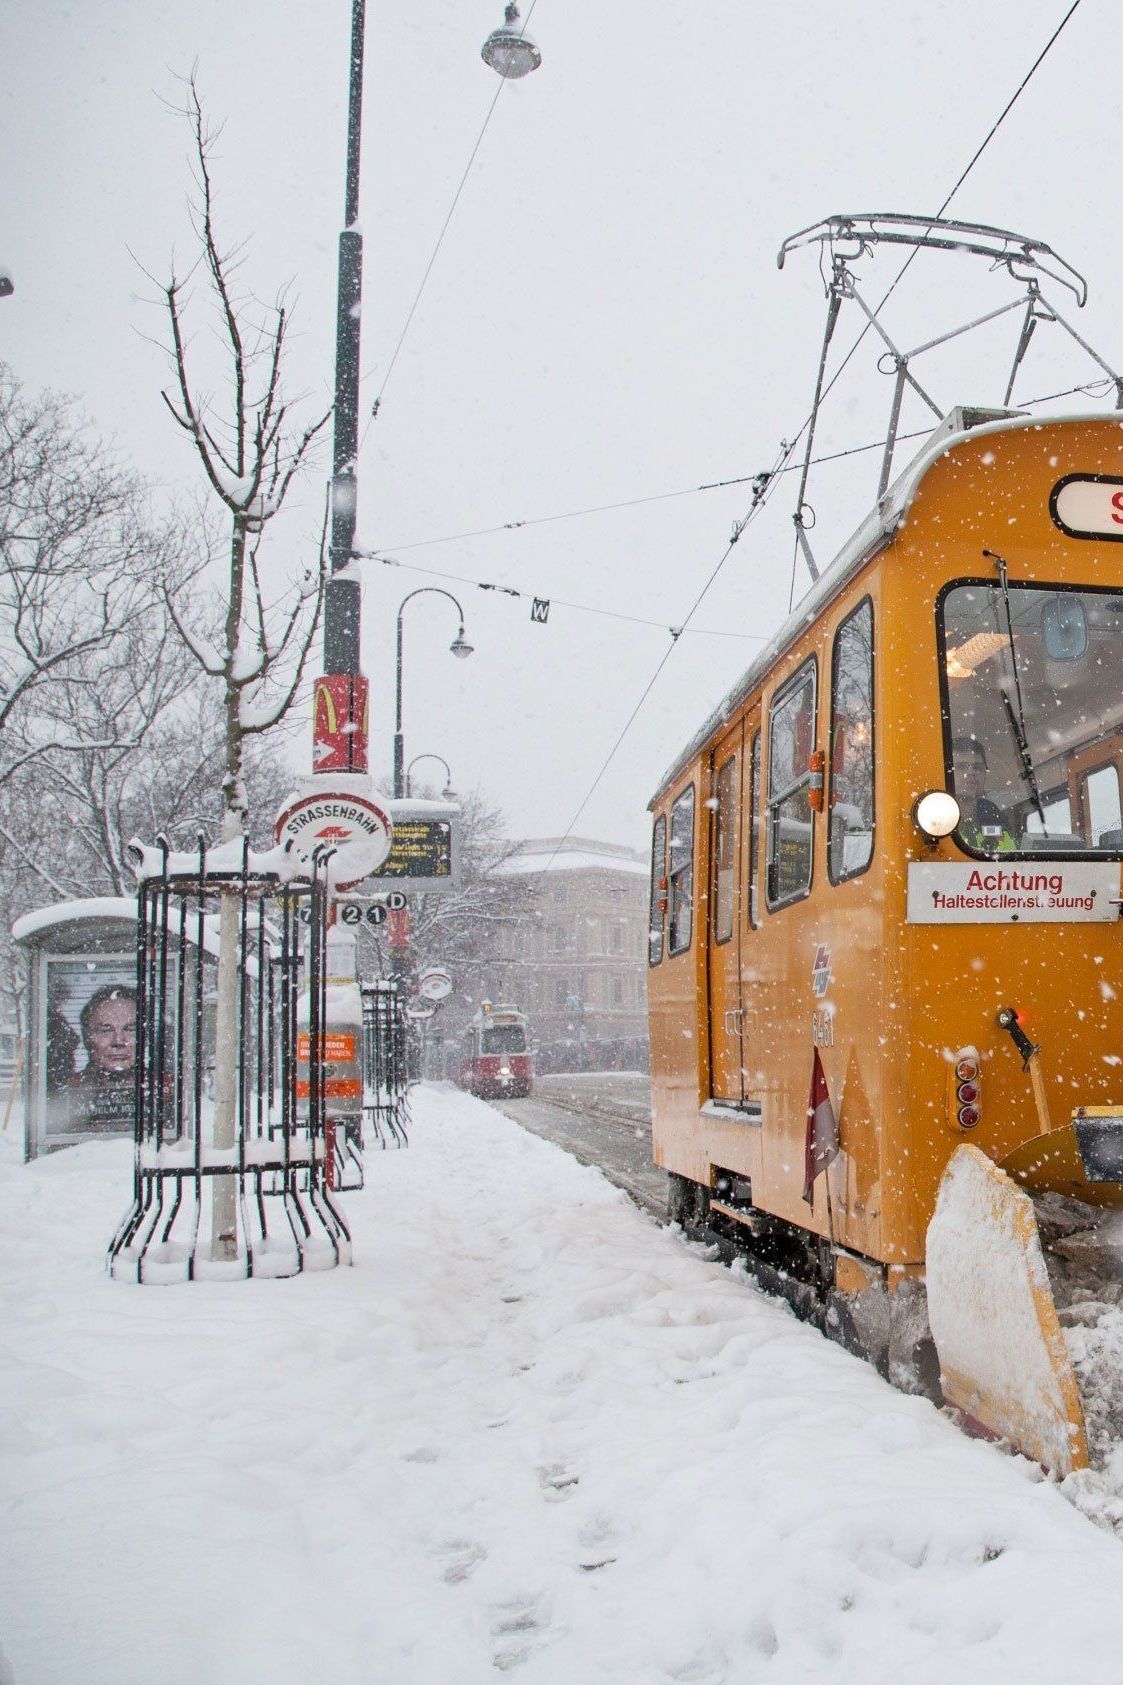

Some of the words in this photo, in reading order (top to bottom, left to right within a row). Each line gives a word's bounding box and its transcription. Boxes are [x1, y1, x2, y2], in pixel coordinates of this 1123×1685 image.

[287, 805, 380, 835] STRASSENBAHN
[966, 870, 1063, 895] Achtung
[390, 894, 405, 909] D
[934, 894, 1095, 911] Haltestellensteuung
[346, 907, 358, 922] 2
[370, 908, 381, 921] 1
